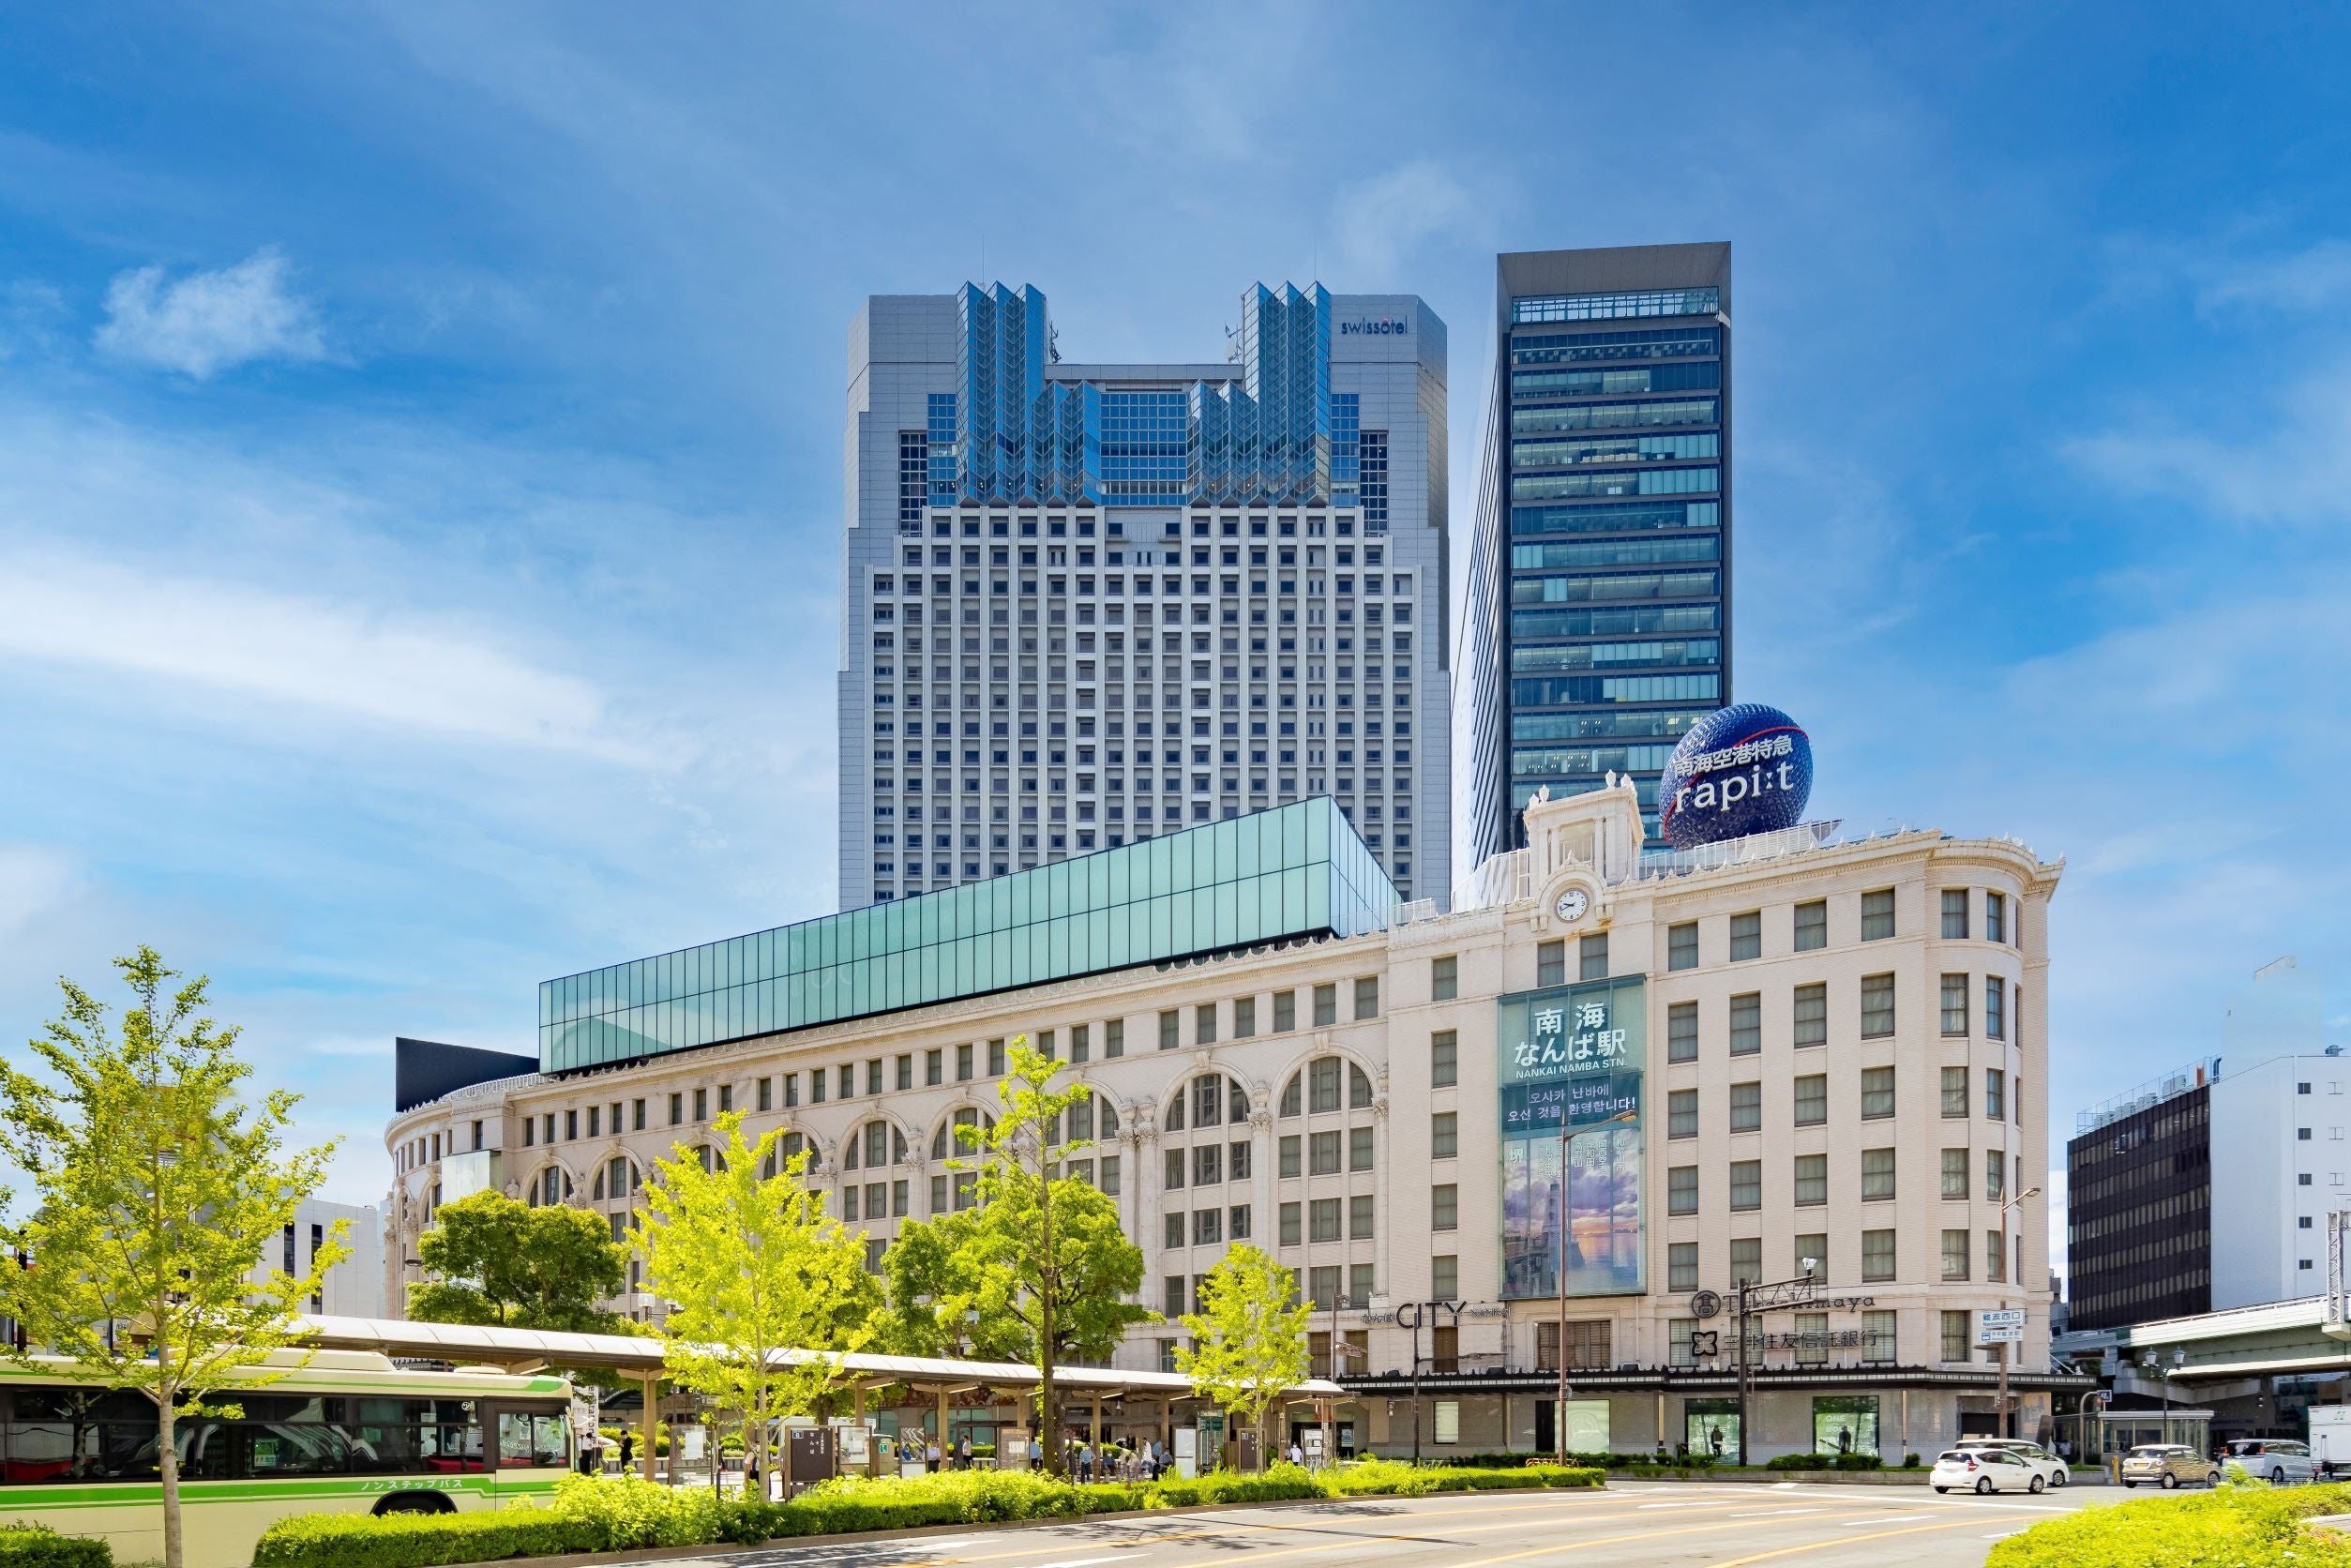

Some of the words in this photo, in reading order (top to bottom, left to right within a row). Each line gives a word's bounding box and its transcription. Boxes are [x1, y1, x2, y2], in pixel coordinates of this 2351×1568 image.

[1674, 734, 1793, 777] 南海空港特急
[1514, 1028, 1627, 1066] なんば駅
[1515, 1067, 1557, 1079] NANKAI
[1559, 1061, 1600, 1074] NAMBA
[1602, 1057, 1627, 1069] STN.
[1529, 1089, 1565, 1104] 오사카
[1572, 1084, 1609, 1099] 난바에
[1507, 1108, 1531, 1122] 오신
[1538, 1105, 1561, 1119] 것을
[1568, 1096, 1635, 1115] 환영합니다!
[1723, 1292, 1876, 1313] Tkhmaya
[1396, 1301, 1468, 1329] CITY
[361, 1479, 463, 1491] ノンステップバス
